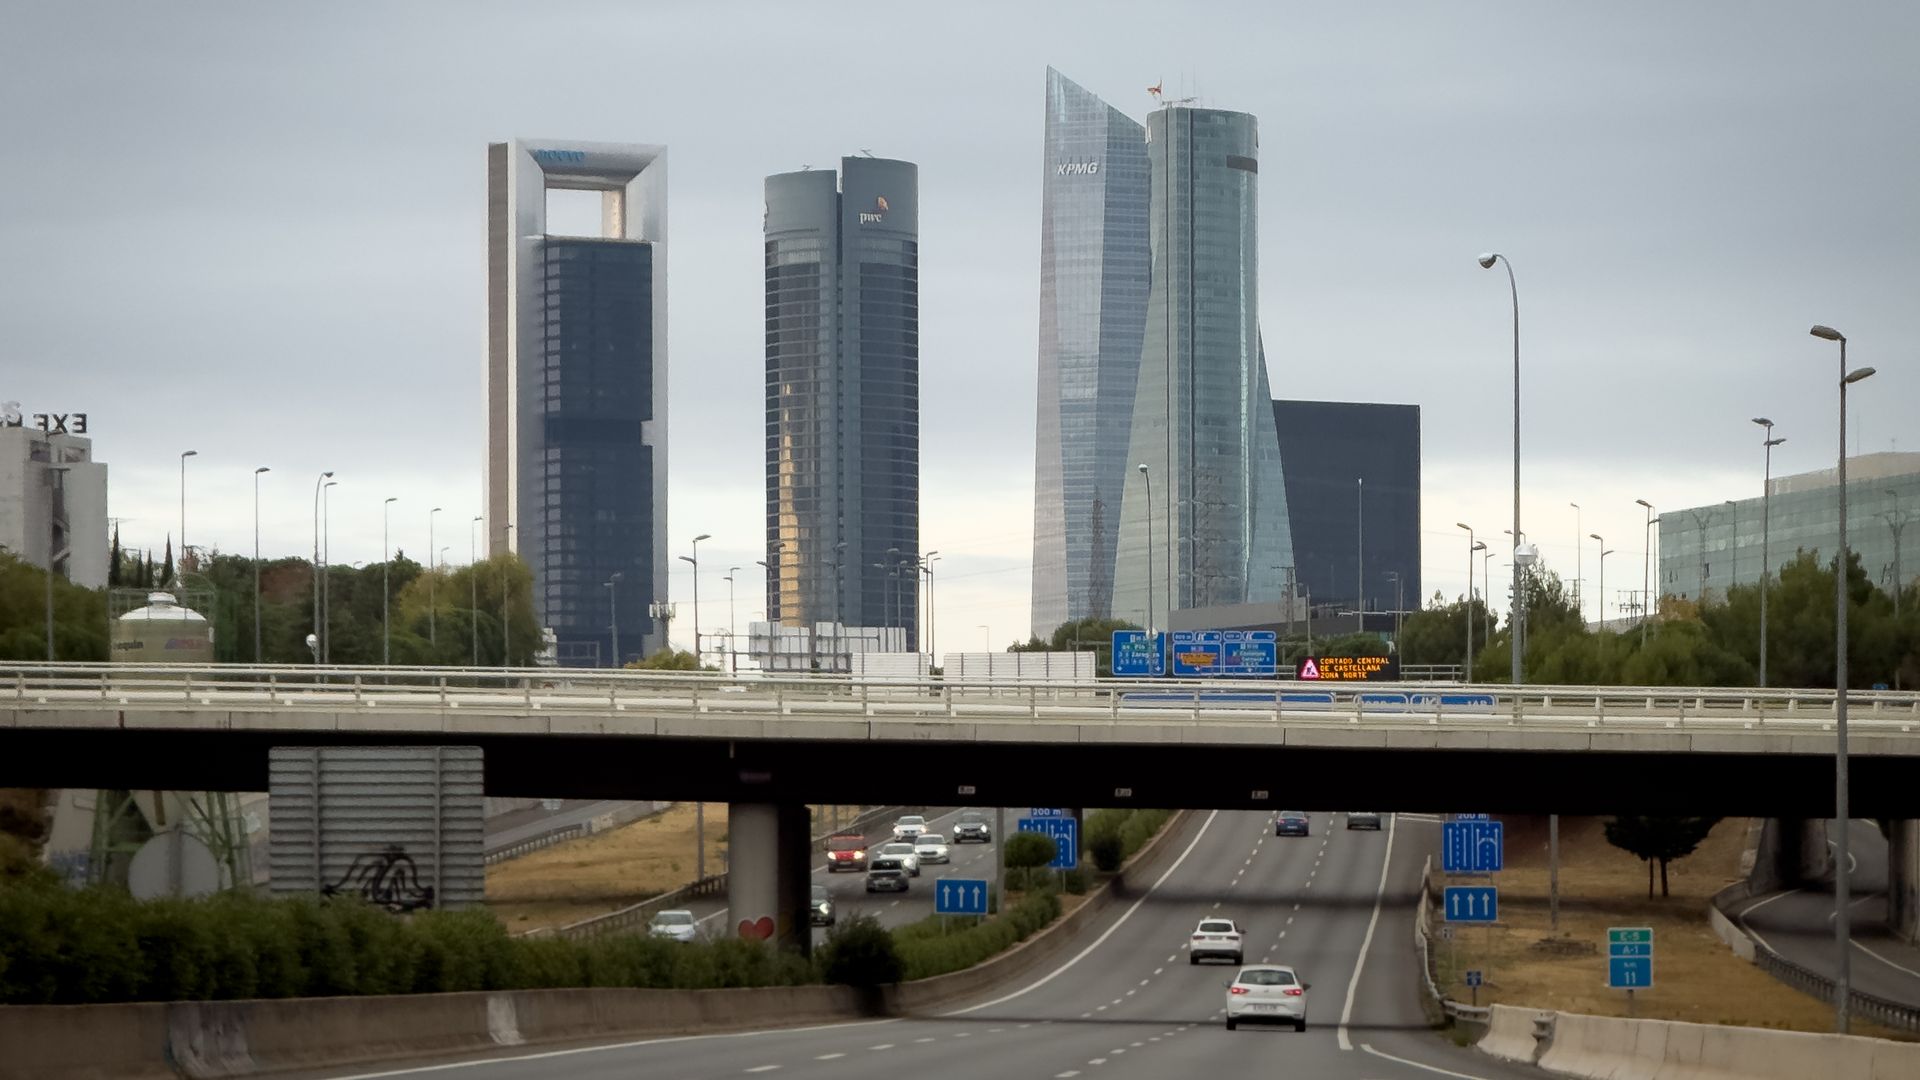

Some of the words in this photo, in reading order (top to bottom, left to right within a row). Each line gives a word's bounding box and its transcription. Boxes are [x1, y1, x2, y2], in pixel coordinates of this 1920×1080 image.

[1057, 162, 1098, 175] KPMG
[859, 212, 882, 224] pwc
[1357, 657, 1390, 665] CENTRAL
[1033, 808, 1050, 816] 200
[1624, 971, 1636, 985] 11
